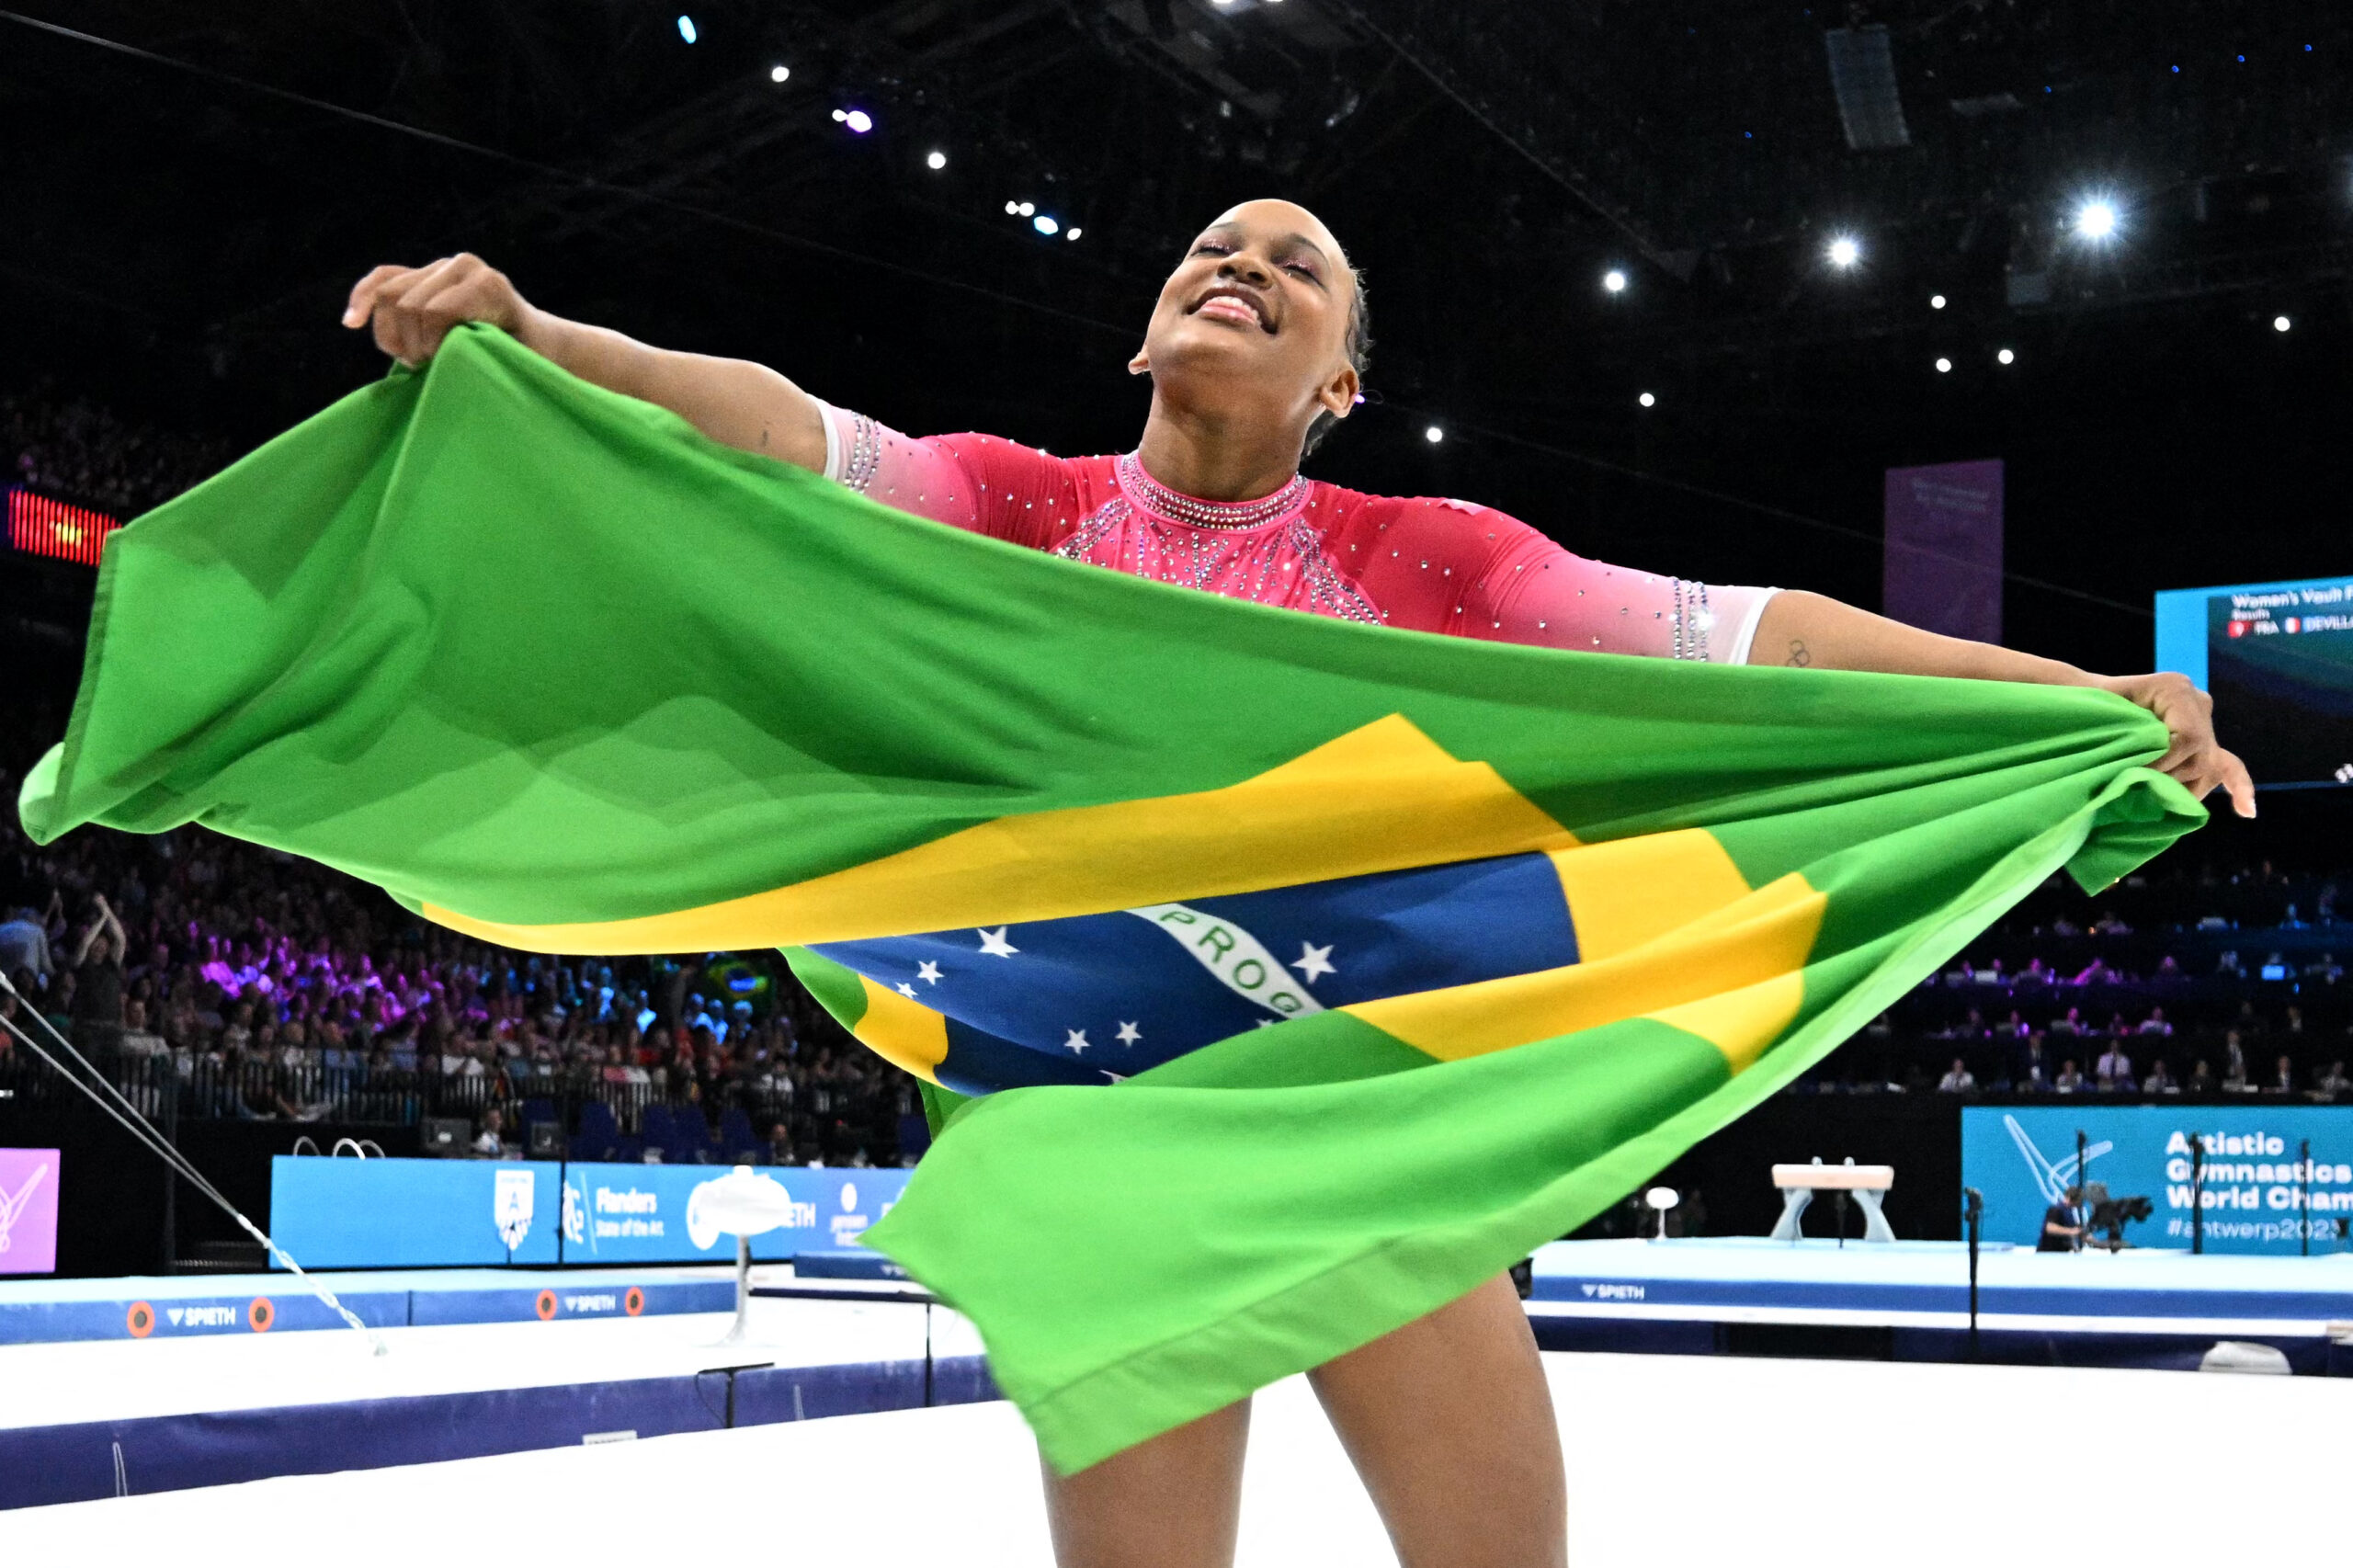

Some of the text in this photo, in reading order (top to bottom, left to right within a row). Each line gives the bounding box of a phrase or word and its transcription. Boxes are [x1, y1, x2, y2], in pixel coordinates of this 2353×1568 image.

[2231, 590, 2299, 608] Women's
[2302, 587, 2342, 605] Vault
[2254, 619, 2279, 636] FRA
[1159, 911, 1303, 1012] PROG
[596, 1186, 657, 1214] Flanders
[2166, 1185, 2353, 1211] World Cham
[1597, 1283, 1645, 1300] SPIETH
[185, 1306, 236, 1326] SPIETH
